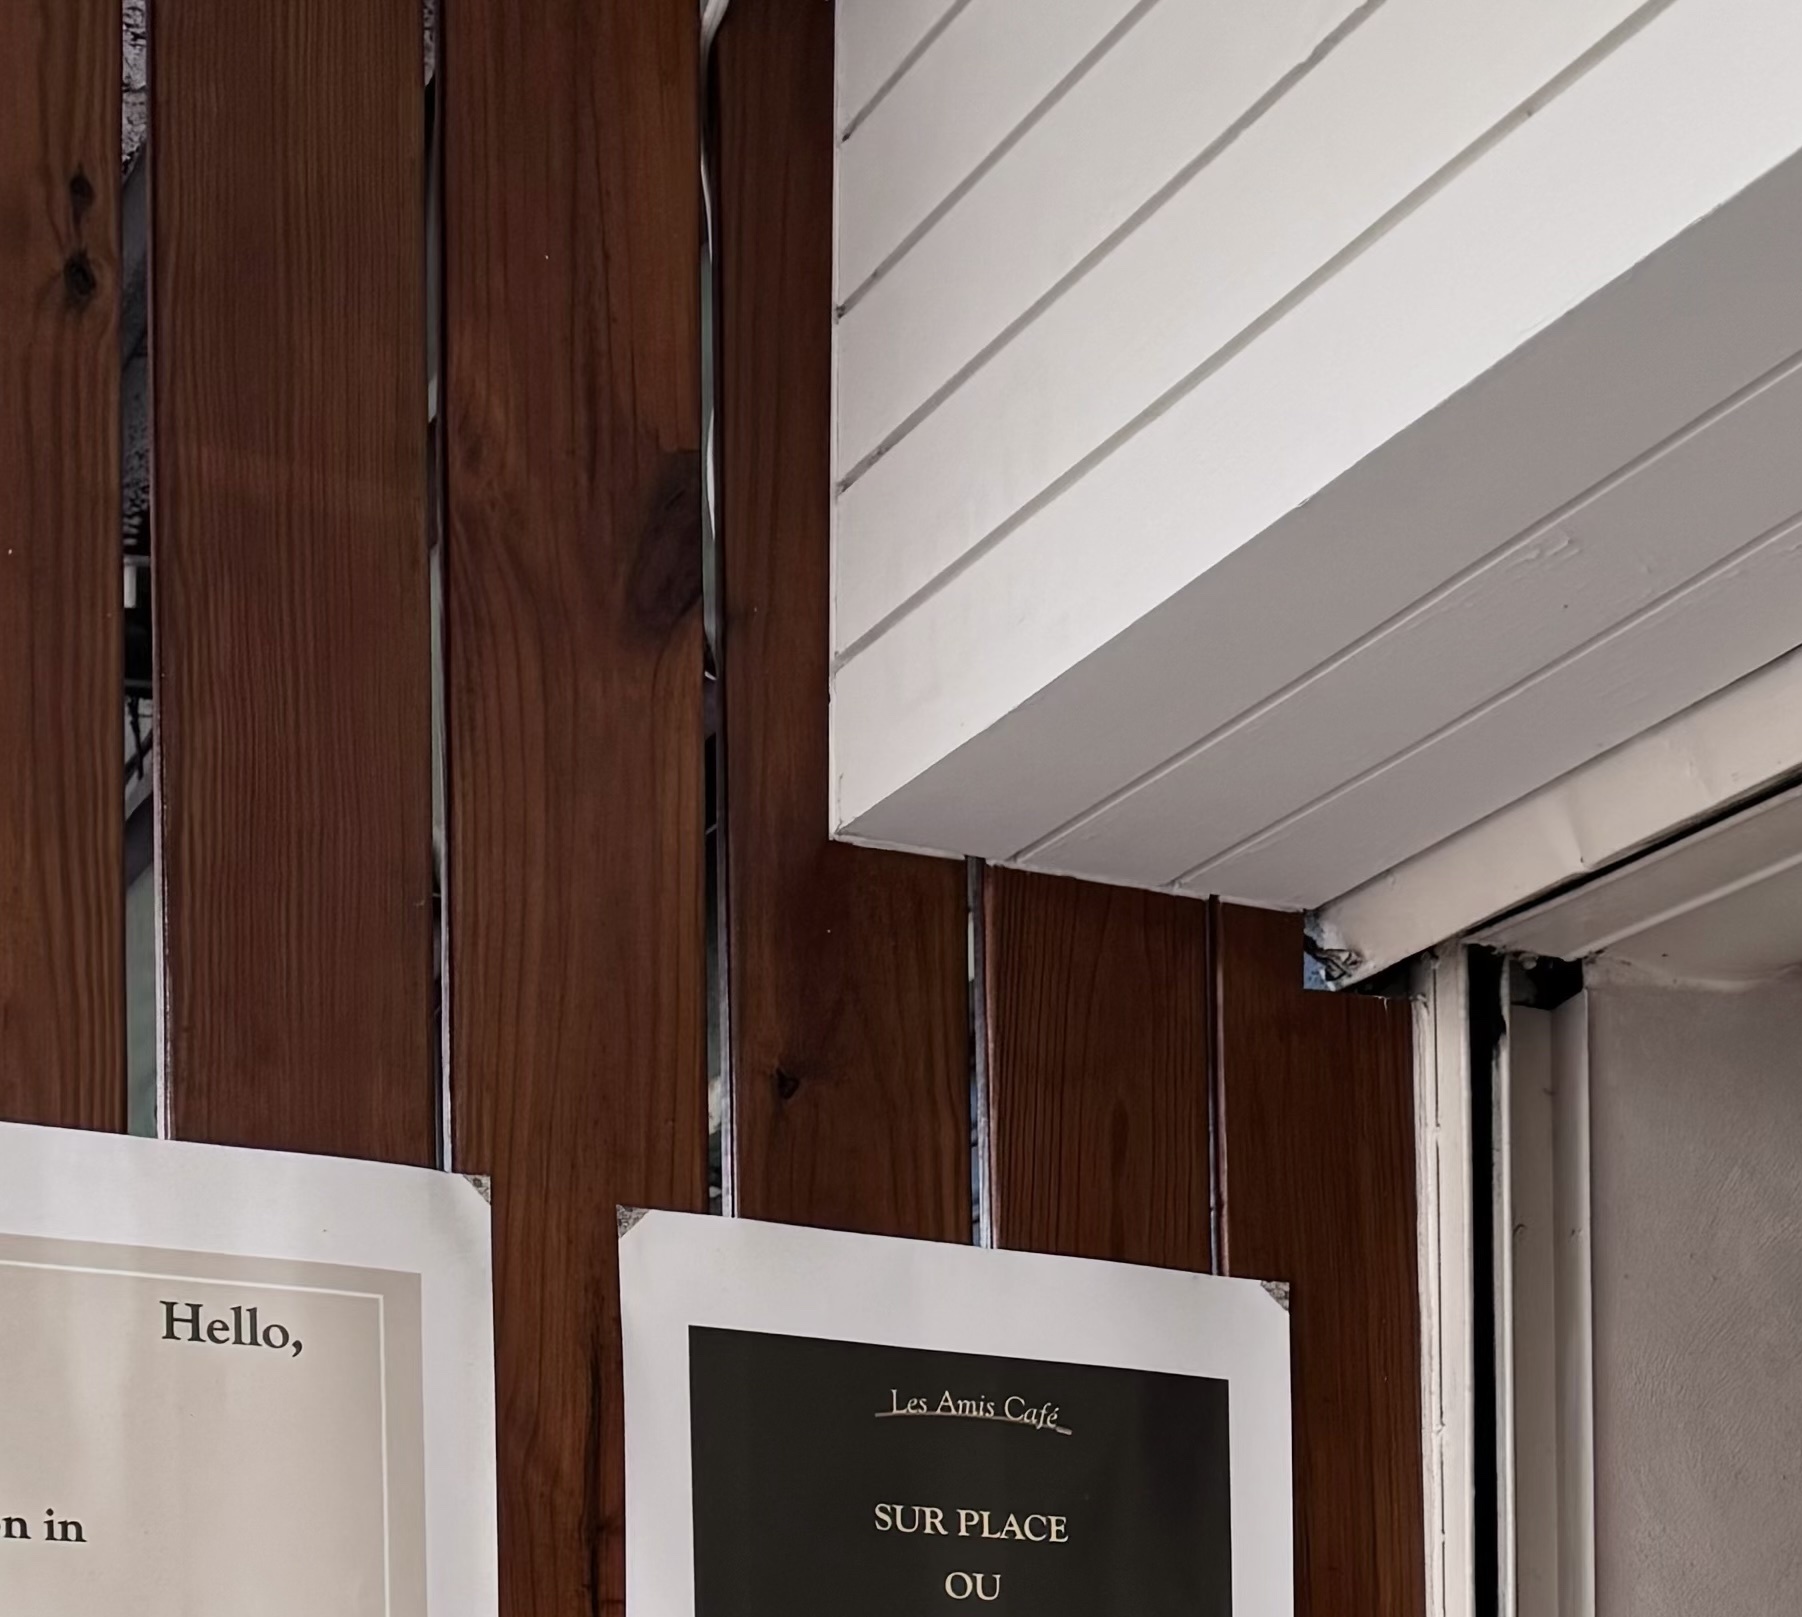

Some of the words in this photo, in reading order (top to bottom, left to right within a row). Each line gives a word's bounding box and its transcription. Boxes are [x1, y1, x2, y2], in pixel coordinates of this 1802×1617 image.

[160, 1300, 303, 1357] Hello,
[889, 1389, 928, 1415] Les
[935, 1390, 995, 1418] Amis
[1004, 1395, 1059, 1429] Café
[44, 1508, 87, 1542] in
[874, 1503, 948, 1535] SUR
[956, 1509, 1069, 1543] PLACE
[945, 1571, 1001, 1601] OU
